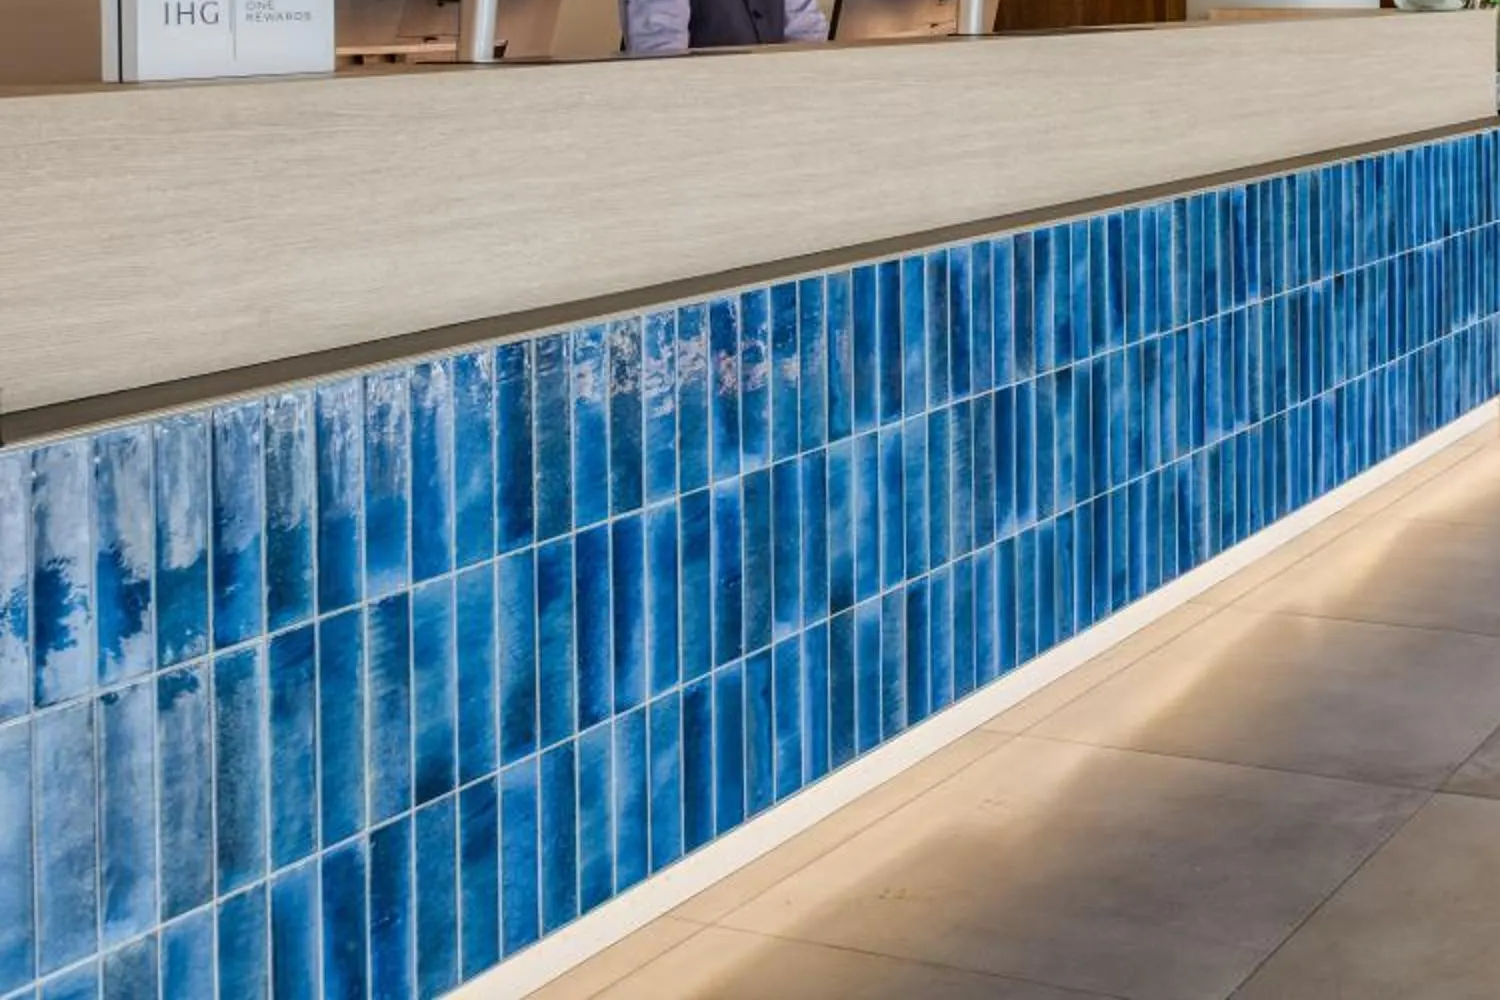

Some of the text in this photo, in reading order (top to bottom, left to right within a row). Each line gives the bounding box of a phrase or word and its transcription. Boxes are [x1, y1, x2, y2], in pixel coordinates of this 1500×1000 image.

[245, 0, 275, 11] ONE
[164, 0, 220, 26] IHG
[245, 11, 312, 22] REWARDS
